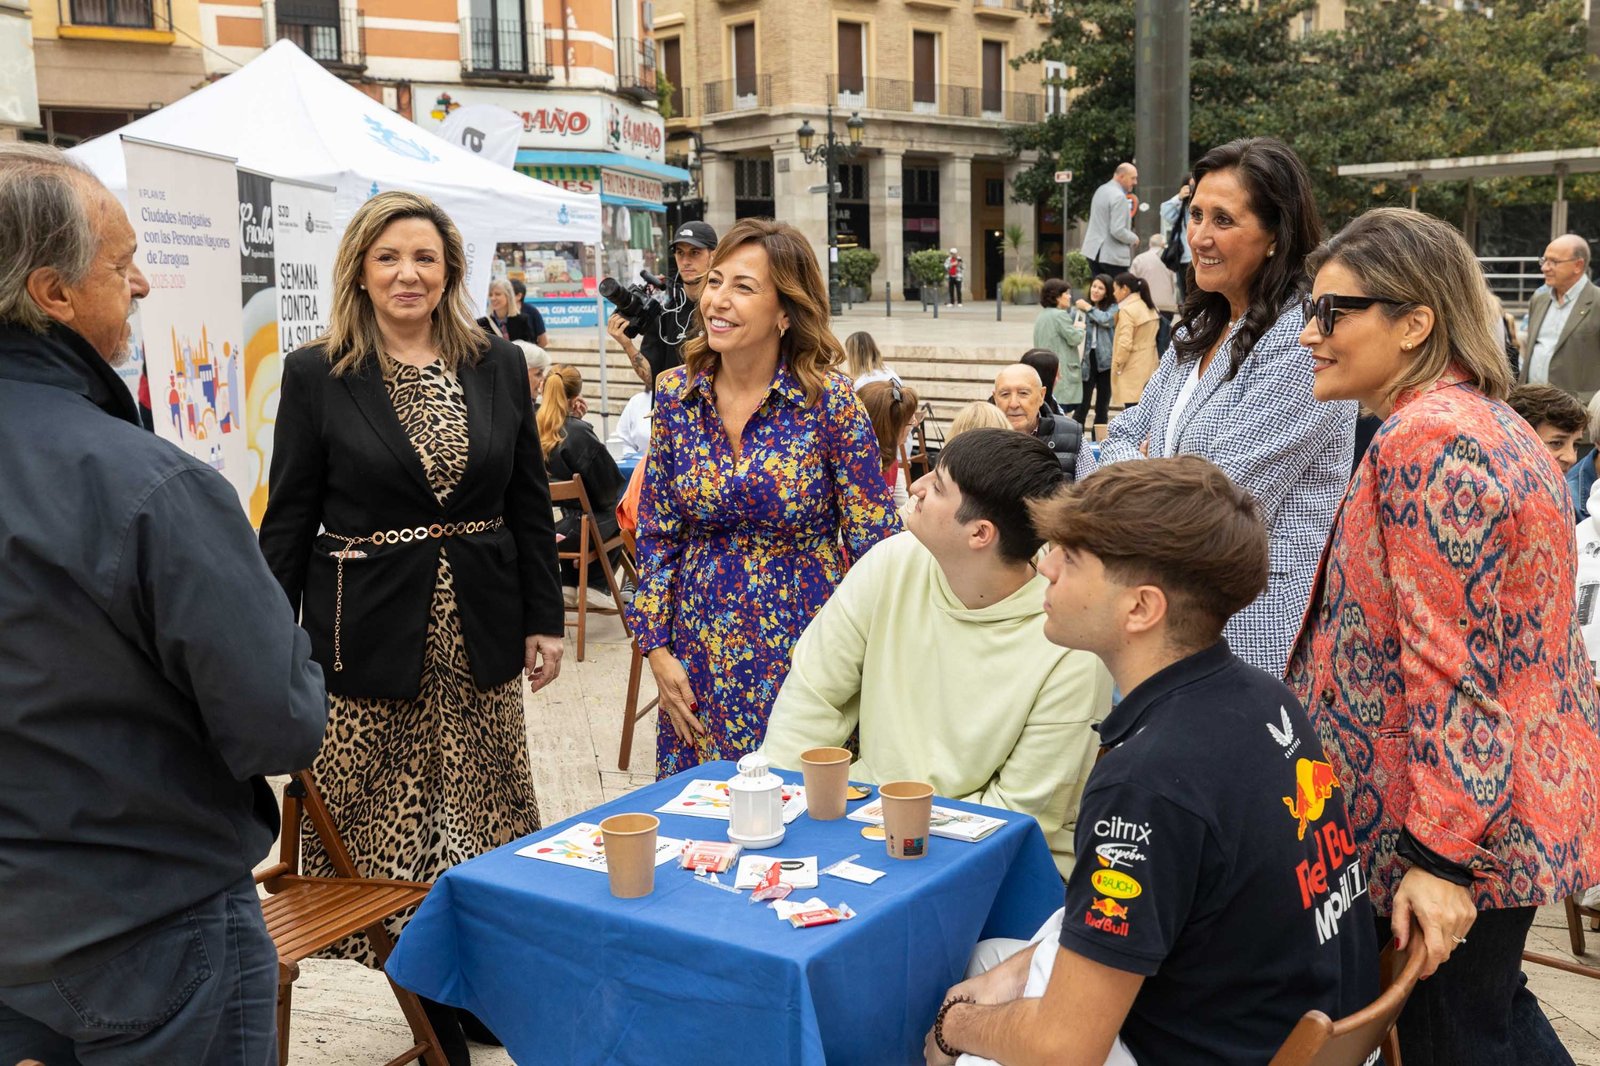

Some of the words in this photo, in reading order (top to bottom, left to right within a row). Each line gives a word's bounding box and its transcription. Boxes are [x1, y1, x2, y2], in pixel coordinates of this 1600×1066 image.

[141, 206, 177, 224] Ciudades
[178, 211, 212, 229] Amigables
[144, 231, 160, 243] con
[160, 229, 171, 245] las
[171, 230, 203, 246] Personas
[203, 233, 230, 250] Mayores
[146, 250, 158, 264] de
[158, 250, 189, 268] Zaragoza
[280, 263, 319, 290] SEMANA
[281, 294, 319, 322] CONTRA
[282, 325, 294, 353] LA
[296, 325, 325, 345] SOL
[1094, 816, 1152, 845] citrix
[1103, 875, 1133, 894] RAUCH
[1103, 914, 1129, 937] Bull
